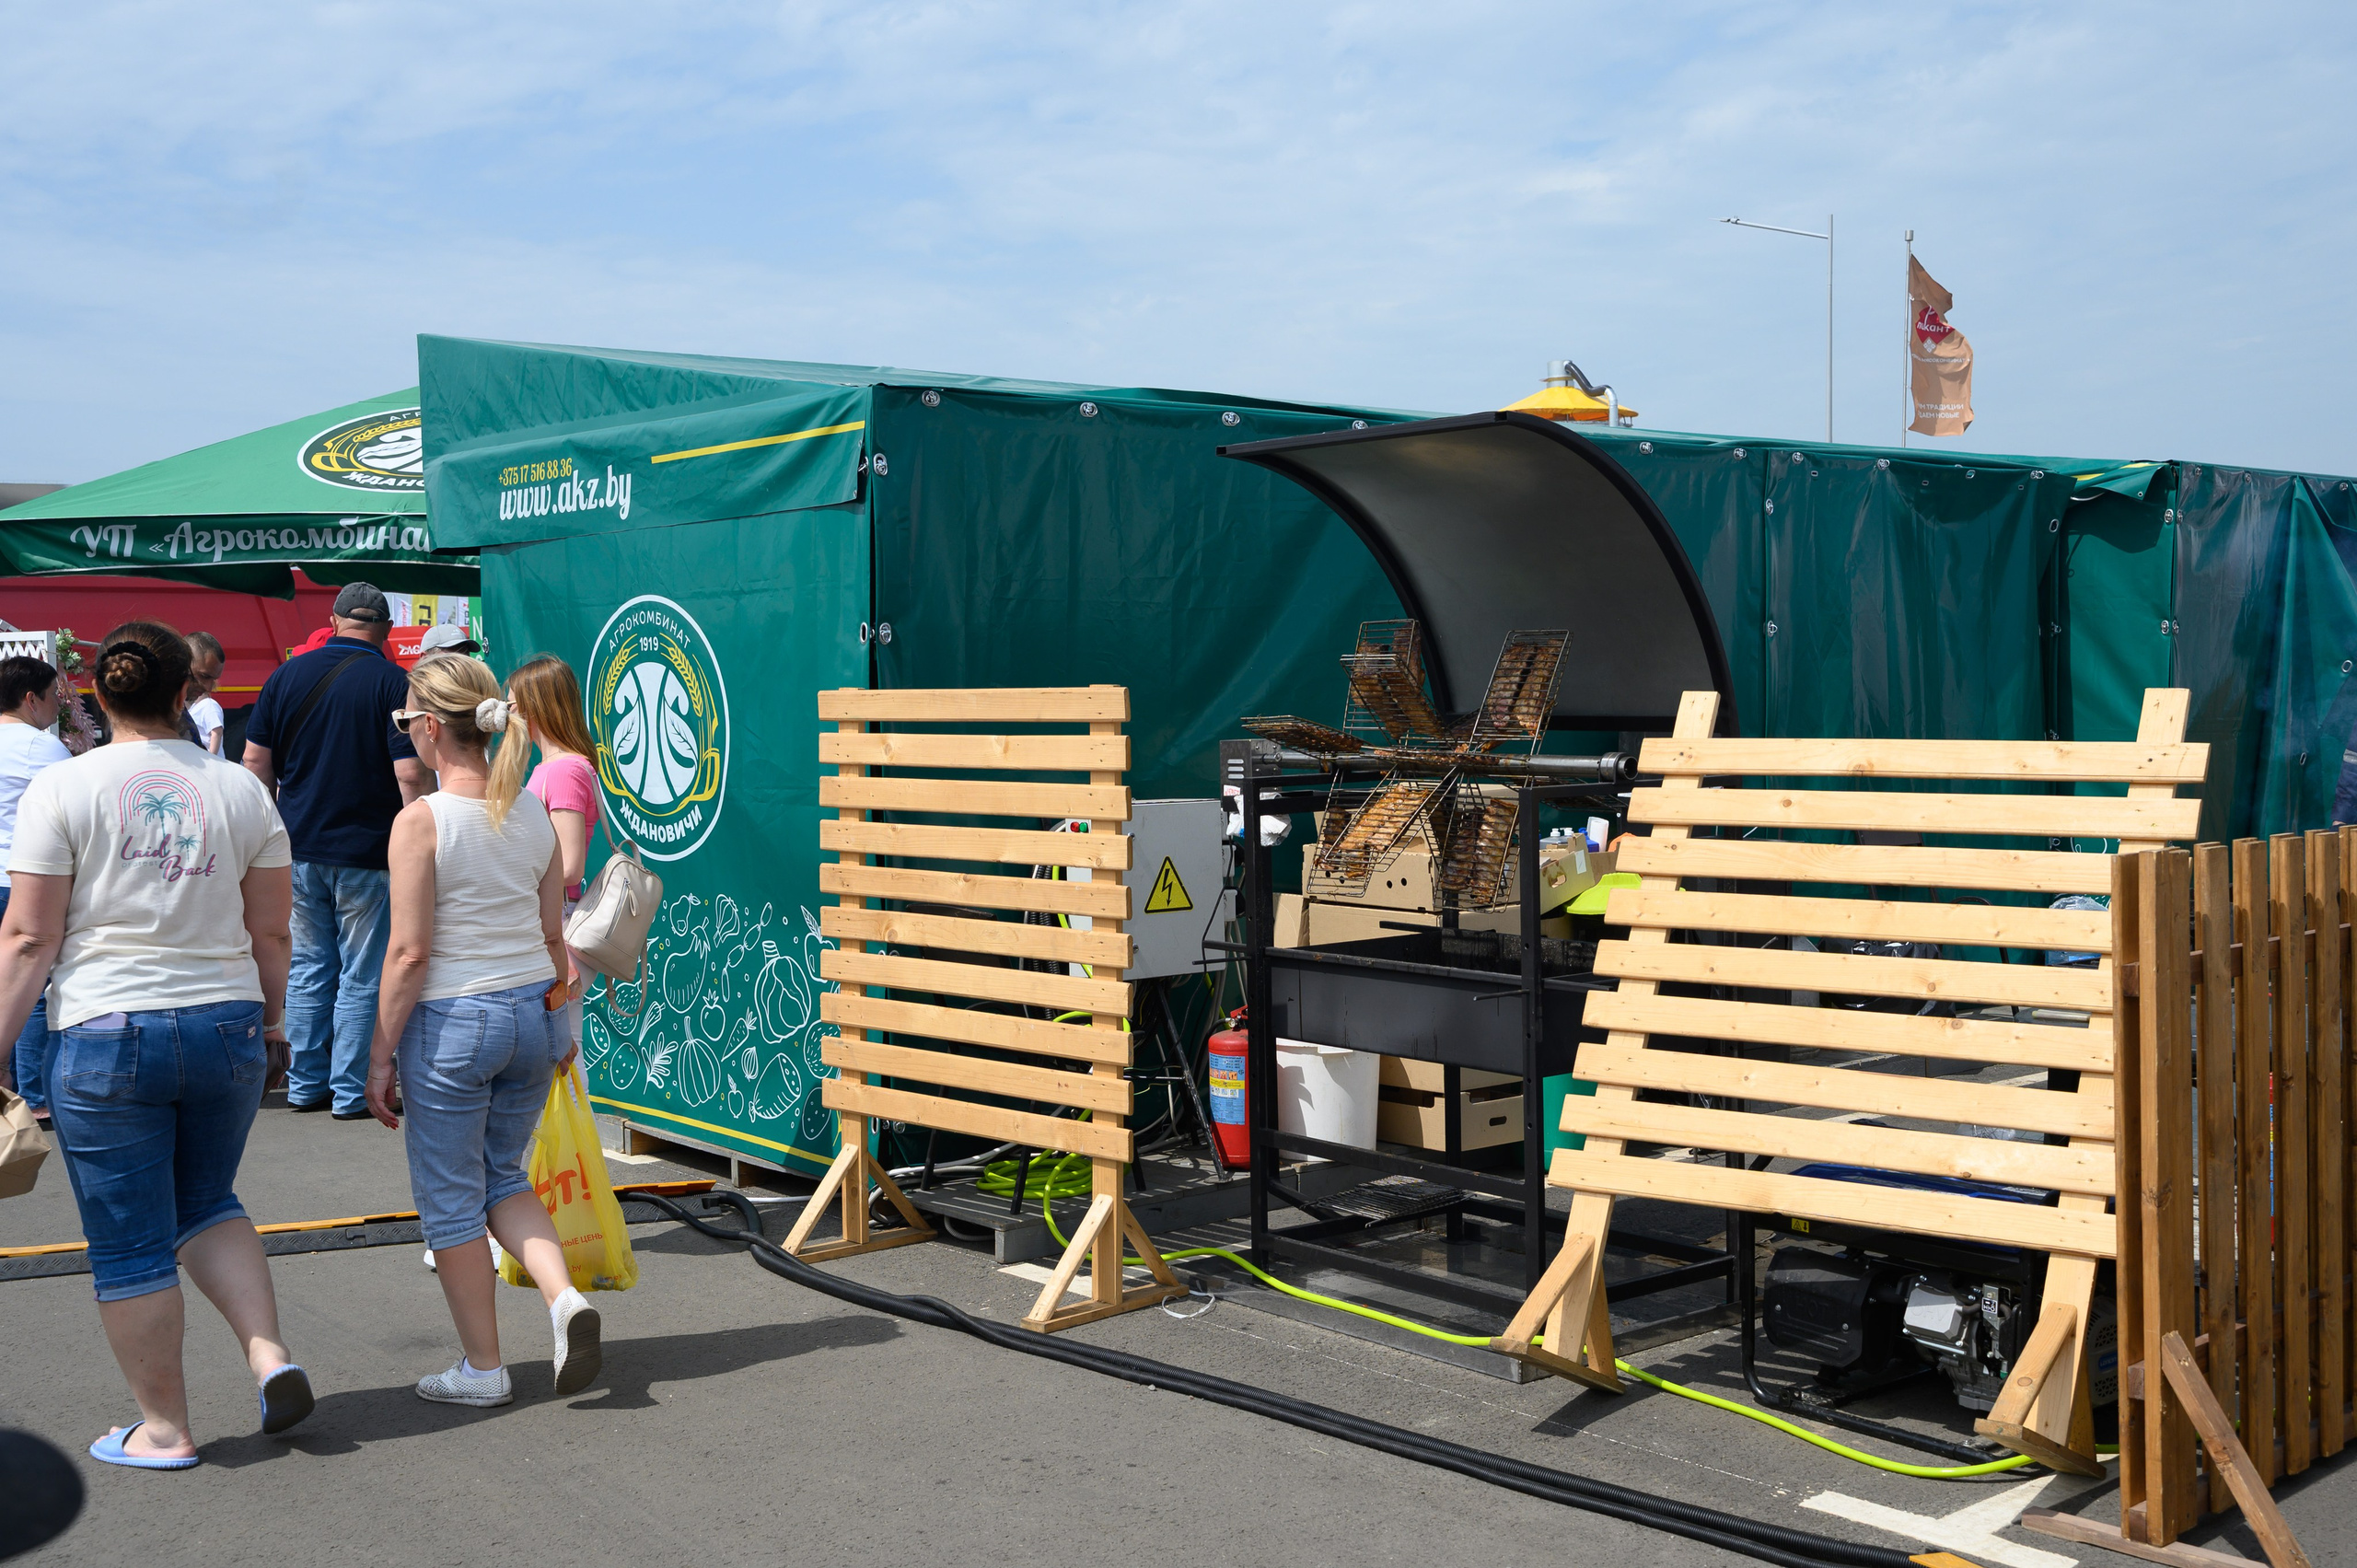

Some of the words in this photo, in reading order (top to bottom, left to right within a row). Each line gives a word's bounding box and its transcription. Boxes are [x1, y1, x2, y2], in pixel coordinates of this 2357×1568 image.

[1926, 402, 1965, 411] ТРАДИЦИИ
[1936, 411, 1960, 419] НОВЫЕ
[498, 467, 519, 487] +375
[520, 464, 529, 483] 17
[530, 461, 546, 482] 516
[547, 459, 559, 480] 88
[560, 458, 573, 477] 36
[499, 464, 632, 521] www.akz.by
[69, 525, 137, 558] УП
[148, 516, 430, 563] «Агрокомбина
[609, 610, 691, 653] АГРОКОМБИНАТ
[639, 636, 659, 652] 1919
[619, 797, 702, 843] ЖДАНОВИЧИ
[121, 833, 171, 861] Laid
[158, 854, 216, 882] Back
